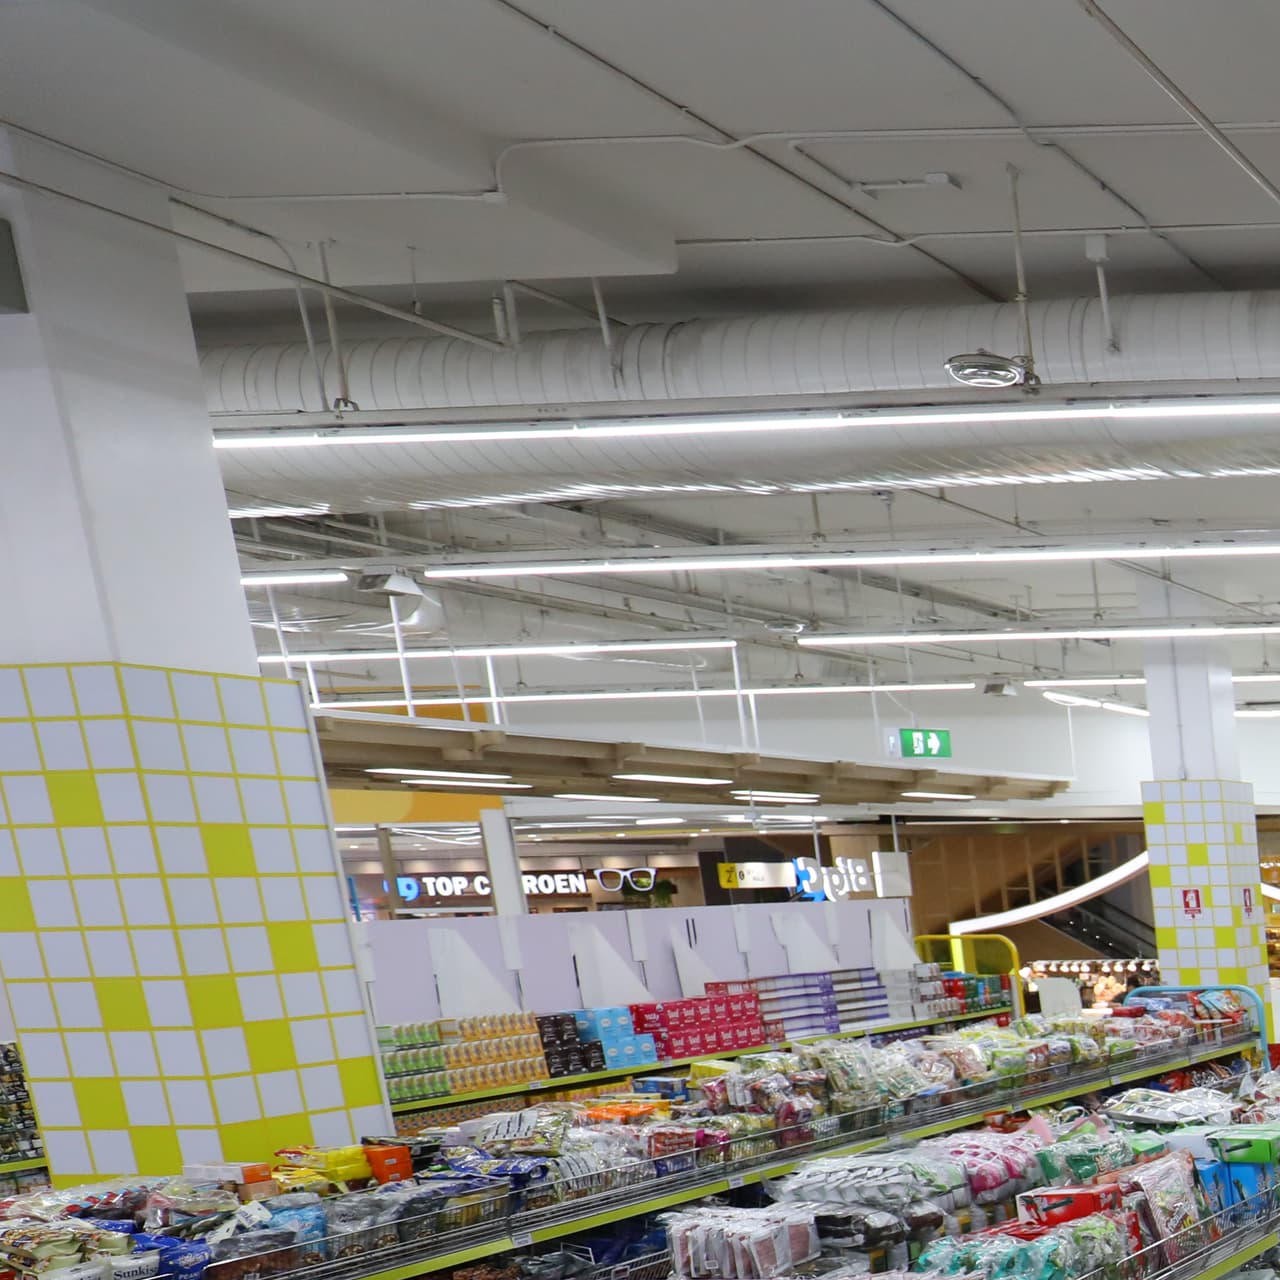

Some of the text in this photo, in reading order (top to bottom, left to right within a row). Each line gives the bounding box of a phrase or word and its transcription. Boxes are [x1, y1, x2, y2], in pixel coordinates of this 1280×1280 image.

[422, 873, 587, 896] TOP CROEN
[113, 1265, 160, 1280] Sunkis
